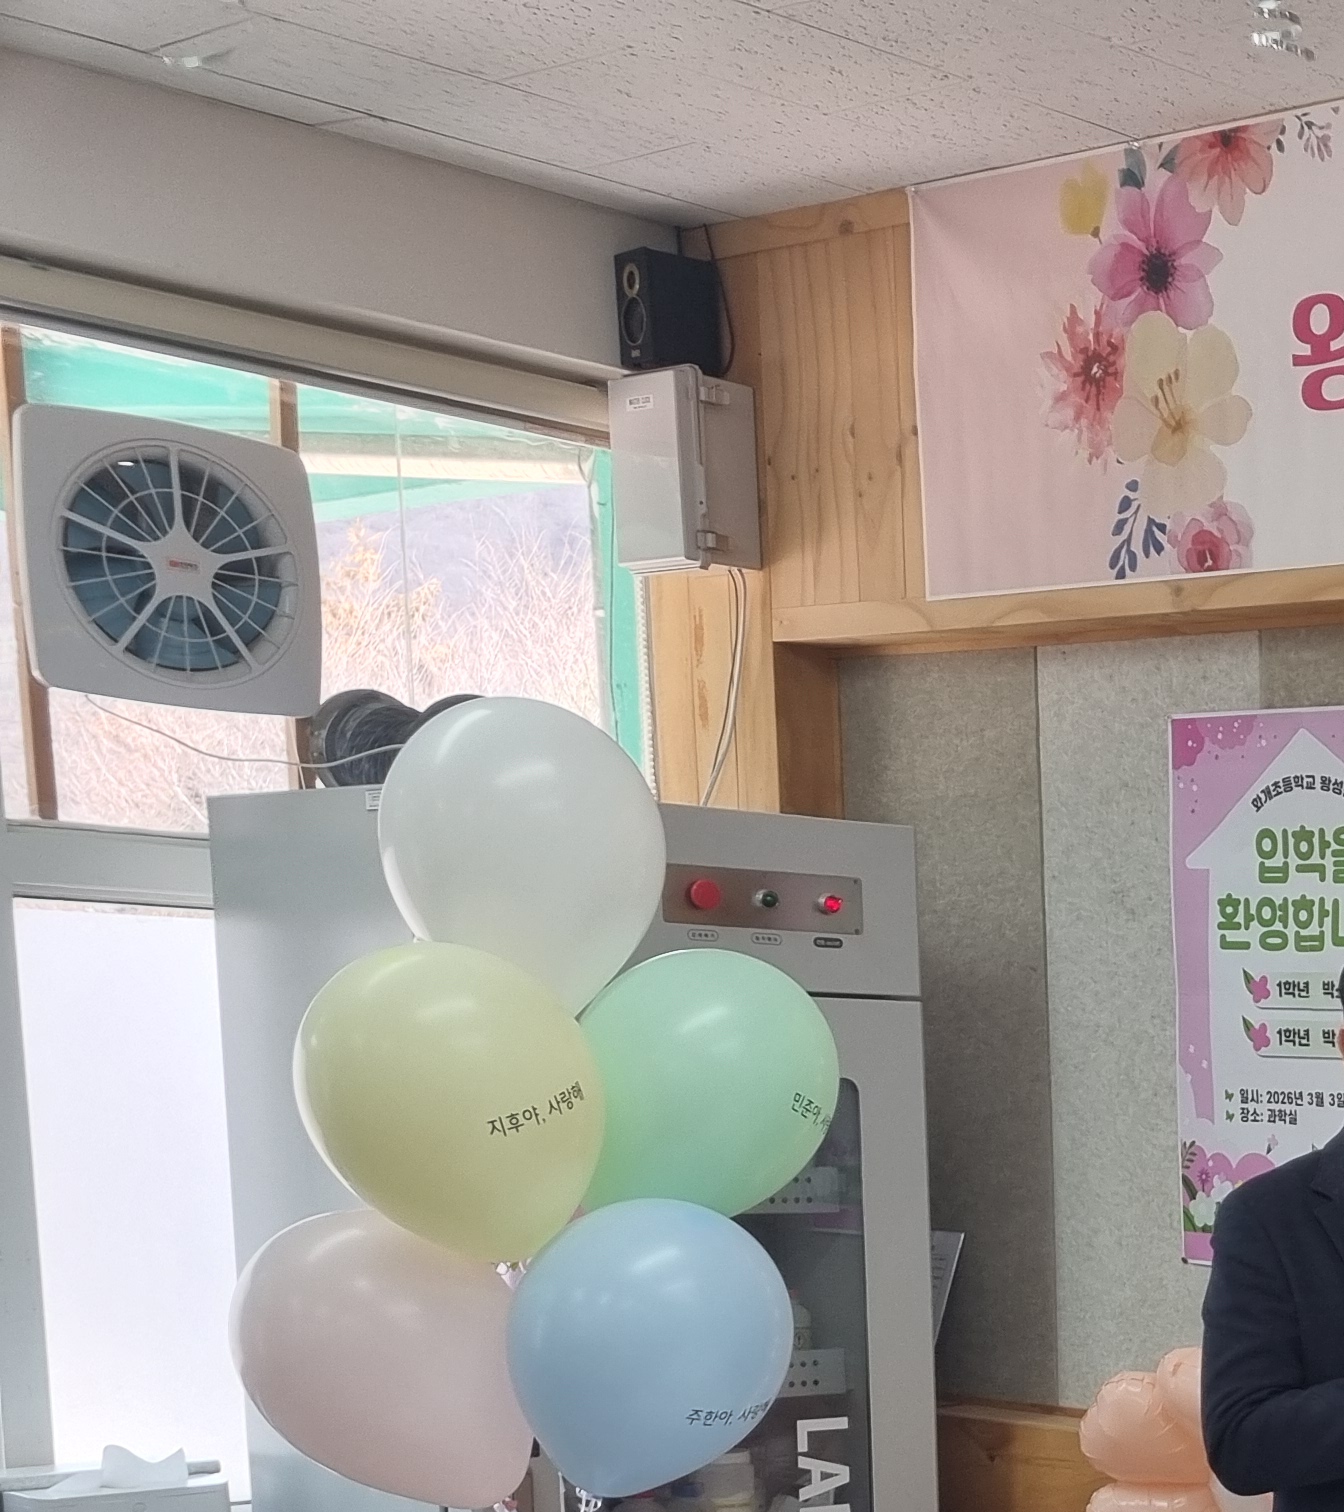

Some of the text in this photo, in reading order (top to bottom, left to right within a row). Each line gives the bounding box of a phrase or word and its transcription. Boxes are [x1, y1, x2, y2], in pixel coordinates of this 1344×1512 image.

[1251, 774, 1317, 813] 화개초등학교
[1276, 980, 1311, 999] 1학년
[1276, 1028, 1311, 1047] 1학년
[1239, 1088, 1264, 1105] 일시:
[1266, 1090, 1304, 1107] 2026년
[1307, 1092, 1325, 1108] 3월
[487, 1080, 584, 1138] 지후야, 사랑해
[1239, 1108, 1298, 1126] 장소: 과학실
